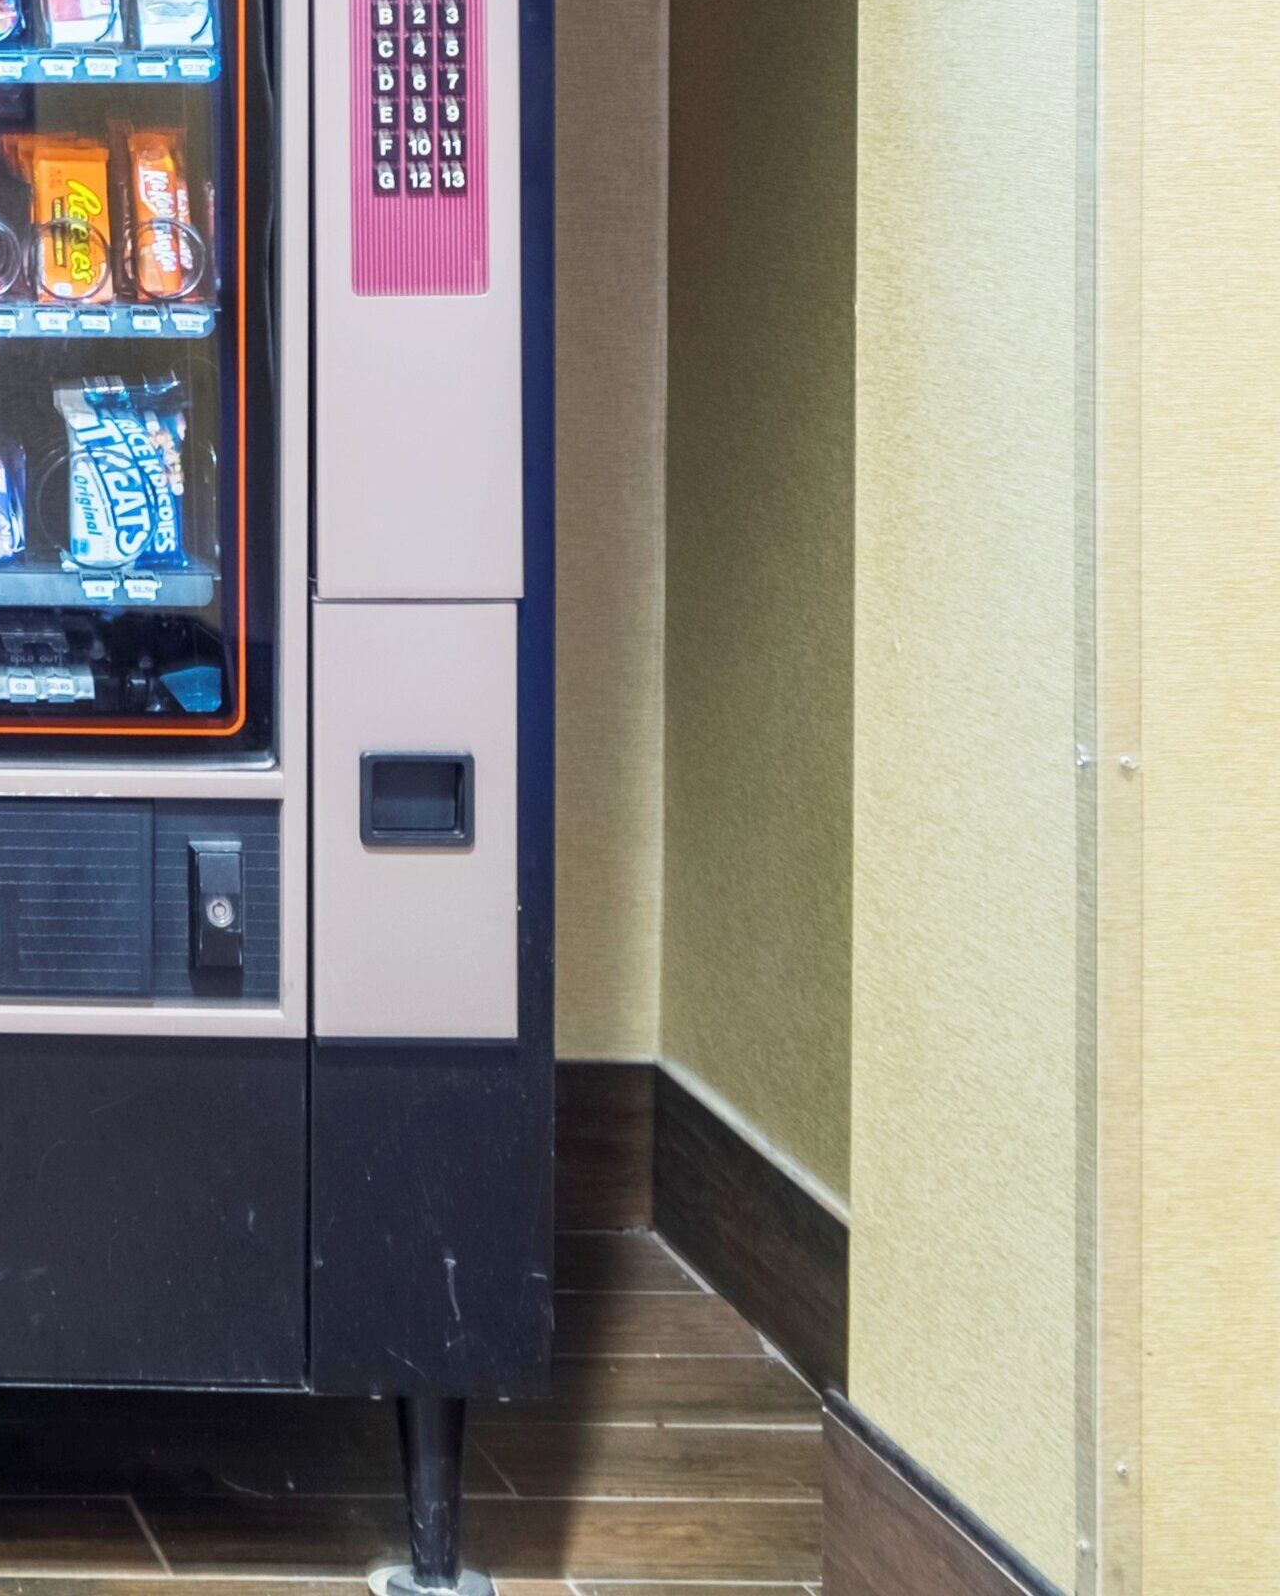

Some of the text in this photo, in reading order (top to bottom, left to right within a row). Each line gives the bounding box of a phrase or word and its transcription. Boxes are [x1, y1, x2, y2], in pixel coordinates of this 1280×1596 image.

[379, 7, 459, 25] B 2 3
[378, 40, 459, 58] C 4 5
[379, 73, 459, 91] D 6 7
[380, 106, 460, 123] E 8 9
[380, 138, 462, 156] F 10 11
[378, 171, 465, 189] G 12 13
[65, 178, 104, 285] Reese's
[73, 475, 103, 536] Original
